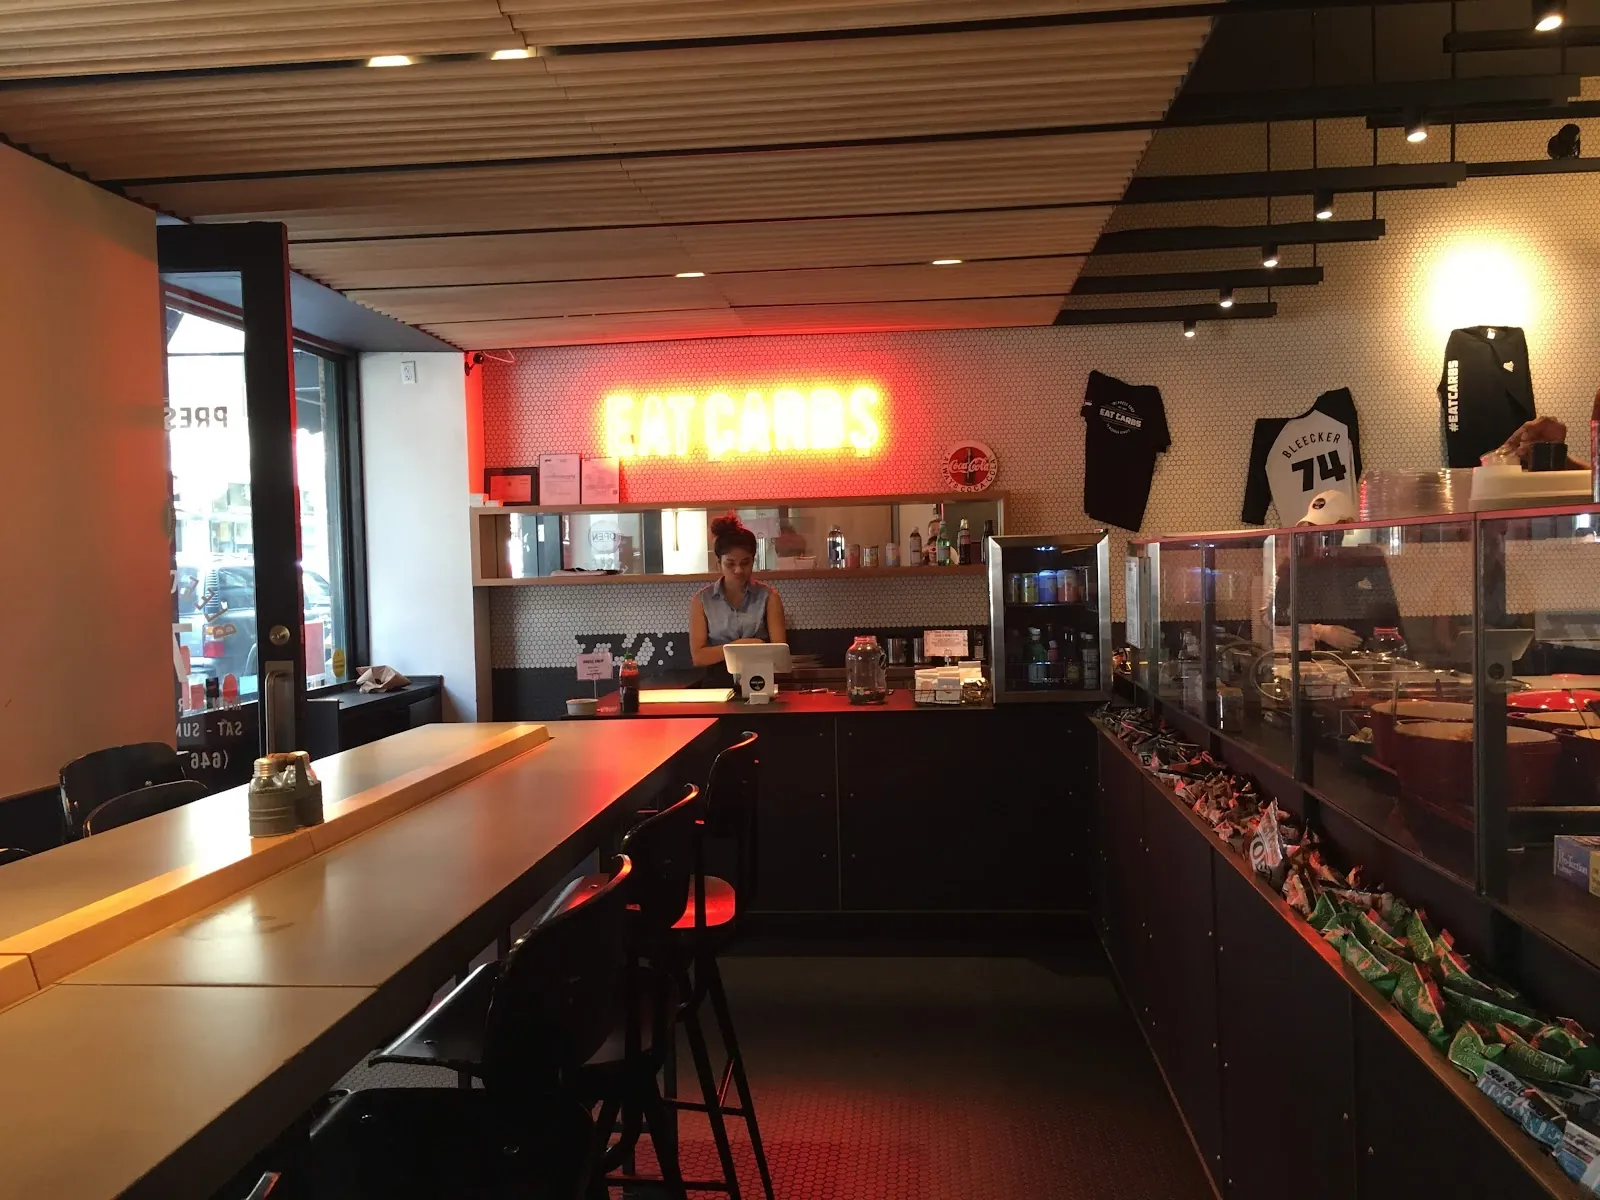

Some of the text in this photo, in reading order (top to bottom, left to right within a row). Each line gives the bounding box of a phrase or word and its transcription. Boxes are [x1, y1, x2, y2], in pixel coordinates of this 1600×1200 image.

[1099, 407, 1115, 419] EAT
[1447, 359, 1460, 433] #EATCARBS
[604, 386, 880, 457] EAT CARBS
[1281, 431, 1341, 459] BLEECKER
[1291, 449, 1347, 492] 74
